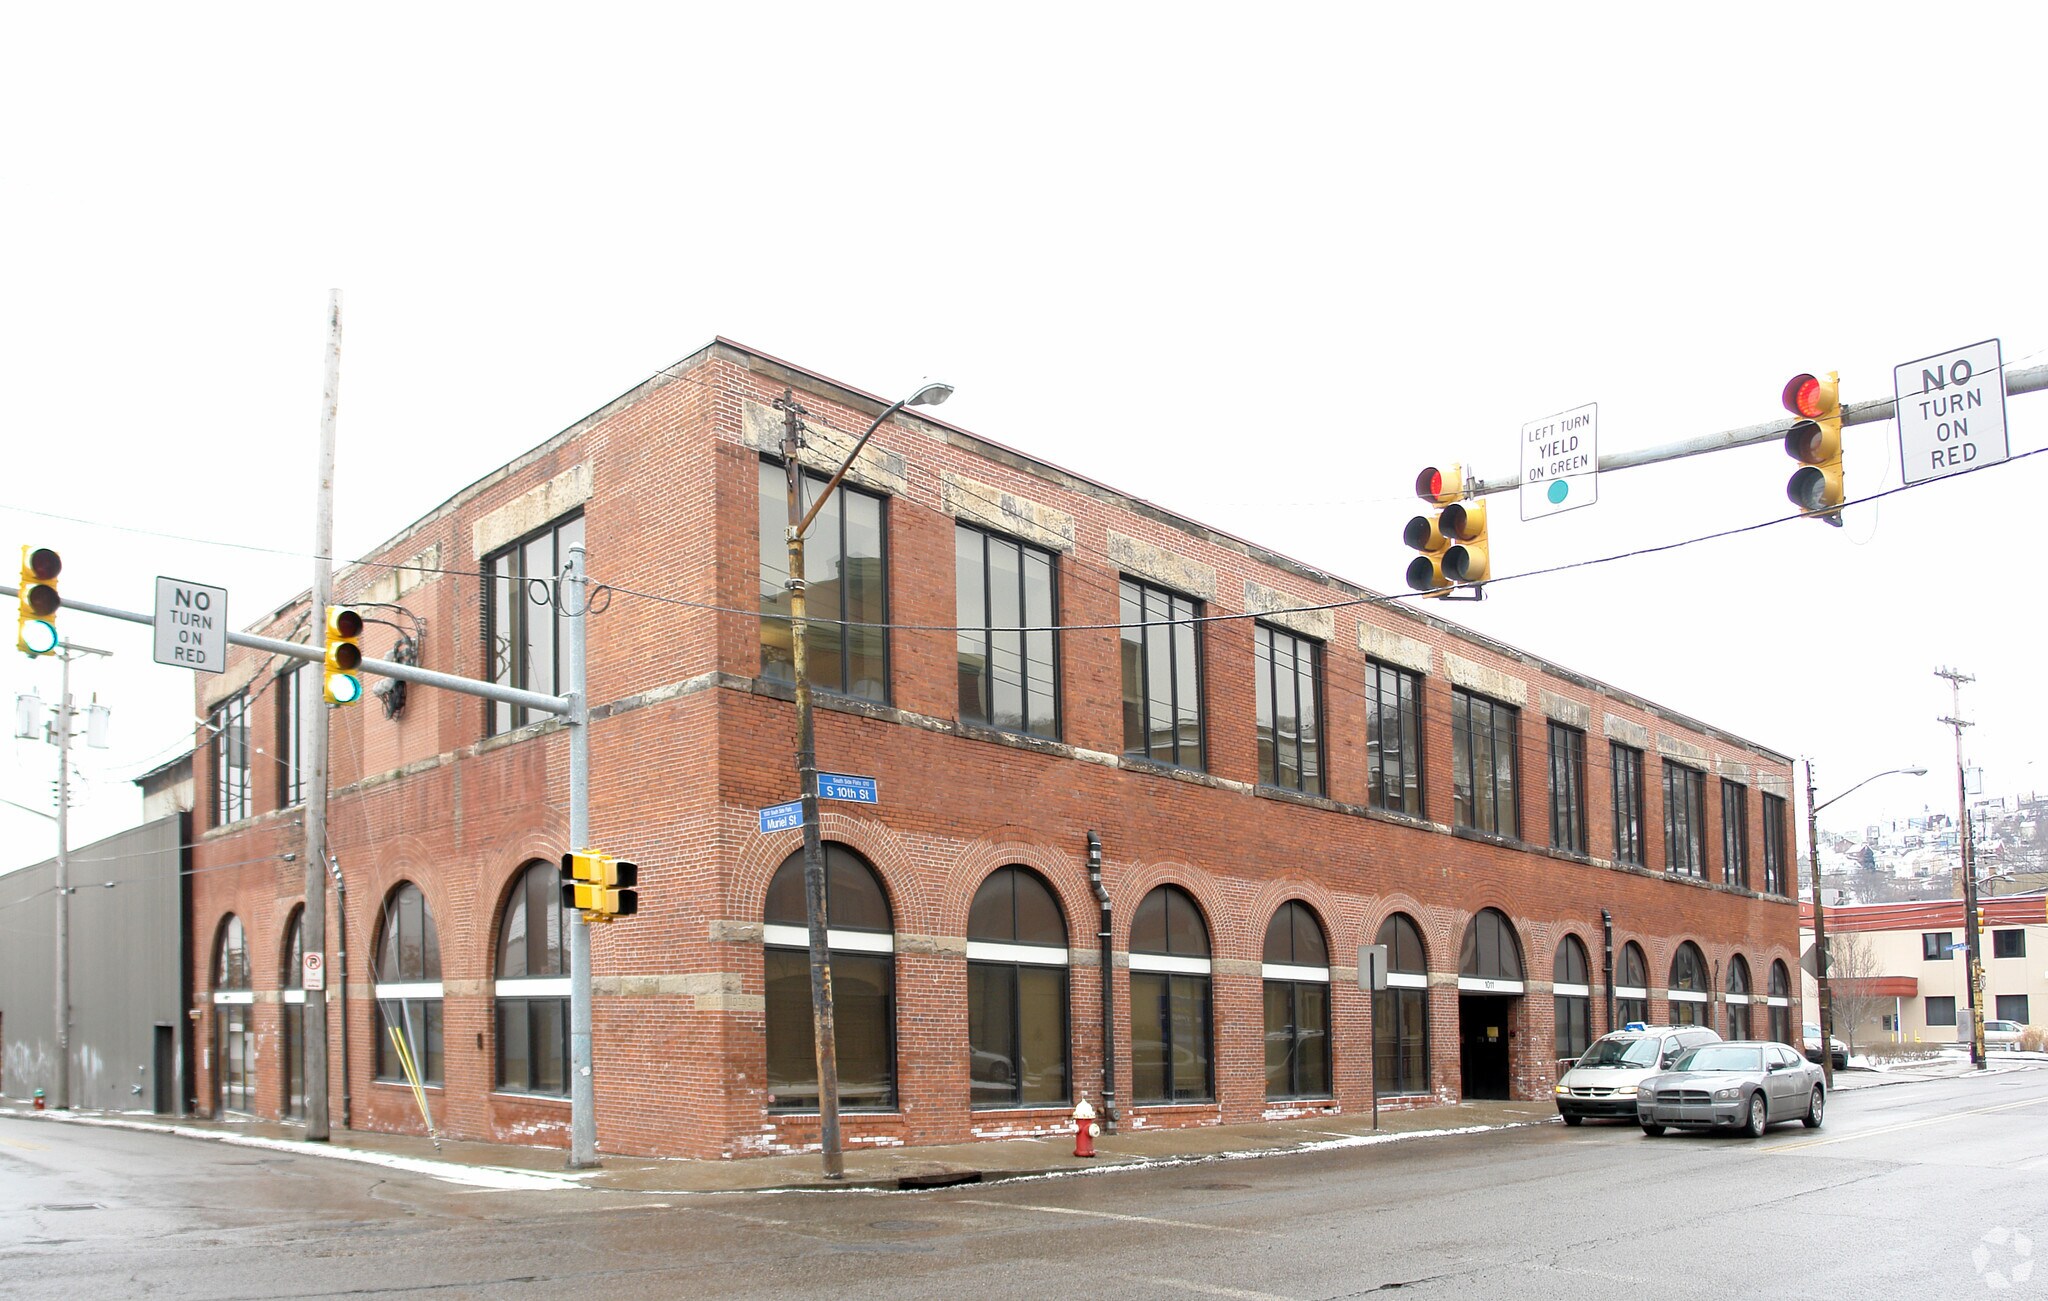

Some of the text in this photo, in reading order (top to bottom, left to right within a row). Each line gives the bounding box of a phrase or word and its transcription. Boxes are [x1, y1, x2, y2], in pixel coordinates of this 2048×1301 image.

[1922, 359, 1972, 394] NO
[1919, 388, 1982, 420] TURN
[1528, 414, 1590, 442] LEFT TURN
[1937, 418, 1968, 442] ON
[1539, 436, 1579, 459] YIELD
[1931, 442, 1977, 469] RED
[1529, 454, 1588, 481] ON GREEN
[175, 588, 210, 611] NO
[170, 610, 212, 630] TURN
[179, 630, 202, 645] ON
[174, 646, 206, 664] RED
[827, 786, 869, 799] S 10th St
[767, 815, 797, 829] Muriel St
